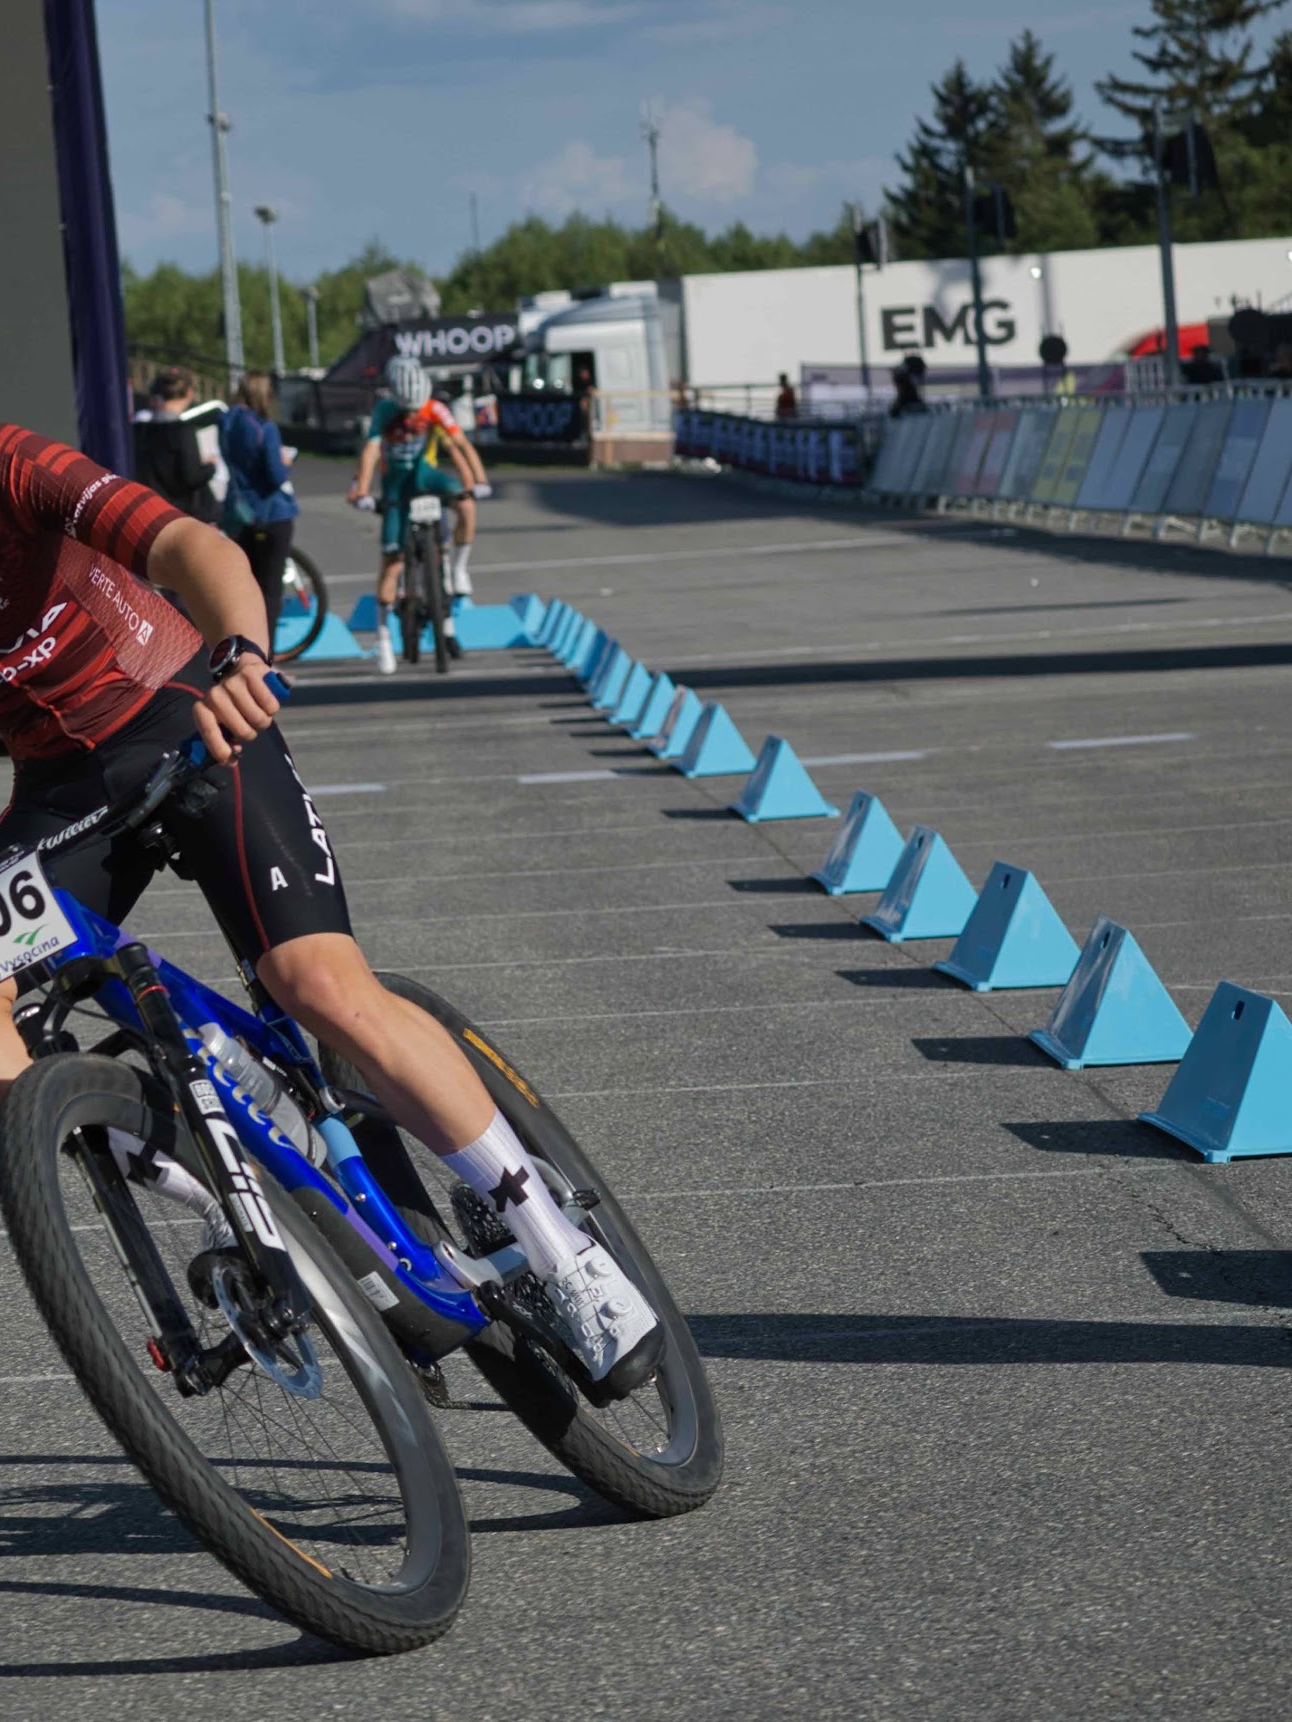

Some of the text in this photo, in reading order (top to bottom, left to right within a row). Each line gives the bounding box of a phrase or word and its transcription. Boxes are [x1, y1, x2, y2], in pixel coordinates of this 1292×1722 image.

[395, 324, 516, 357] WHOOP
[881, 300, 1016, 350] EMG
[89, 565, 116, 599] VERTE
[112, 590, 140, 631] AUTO
